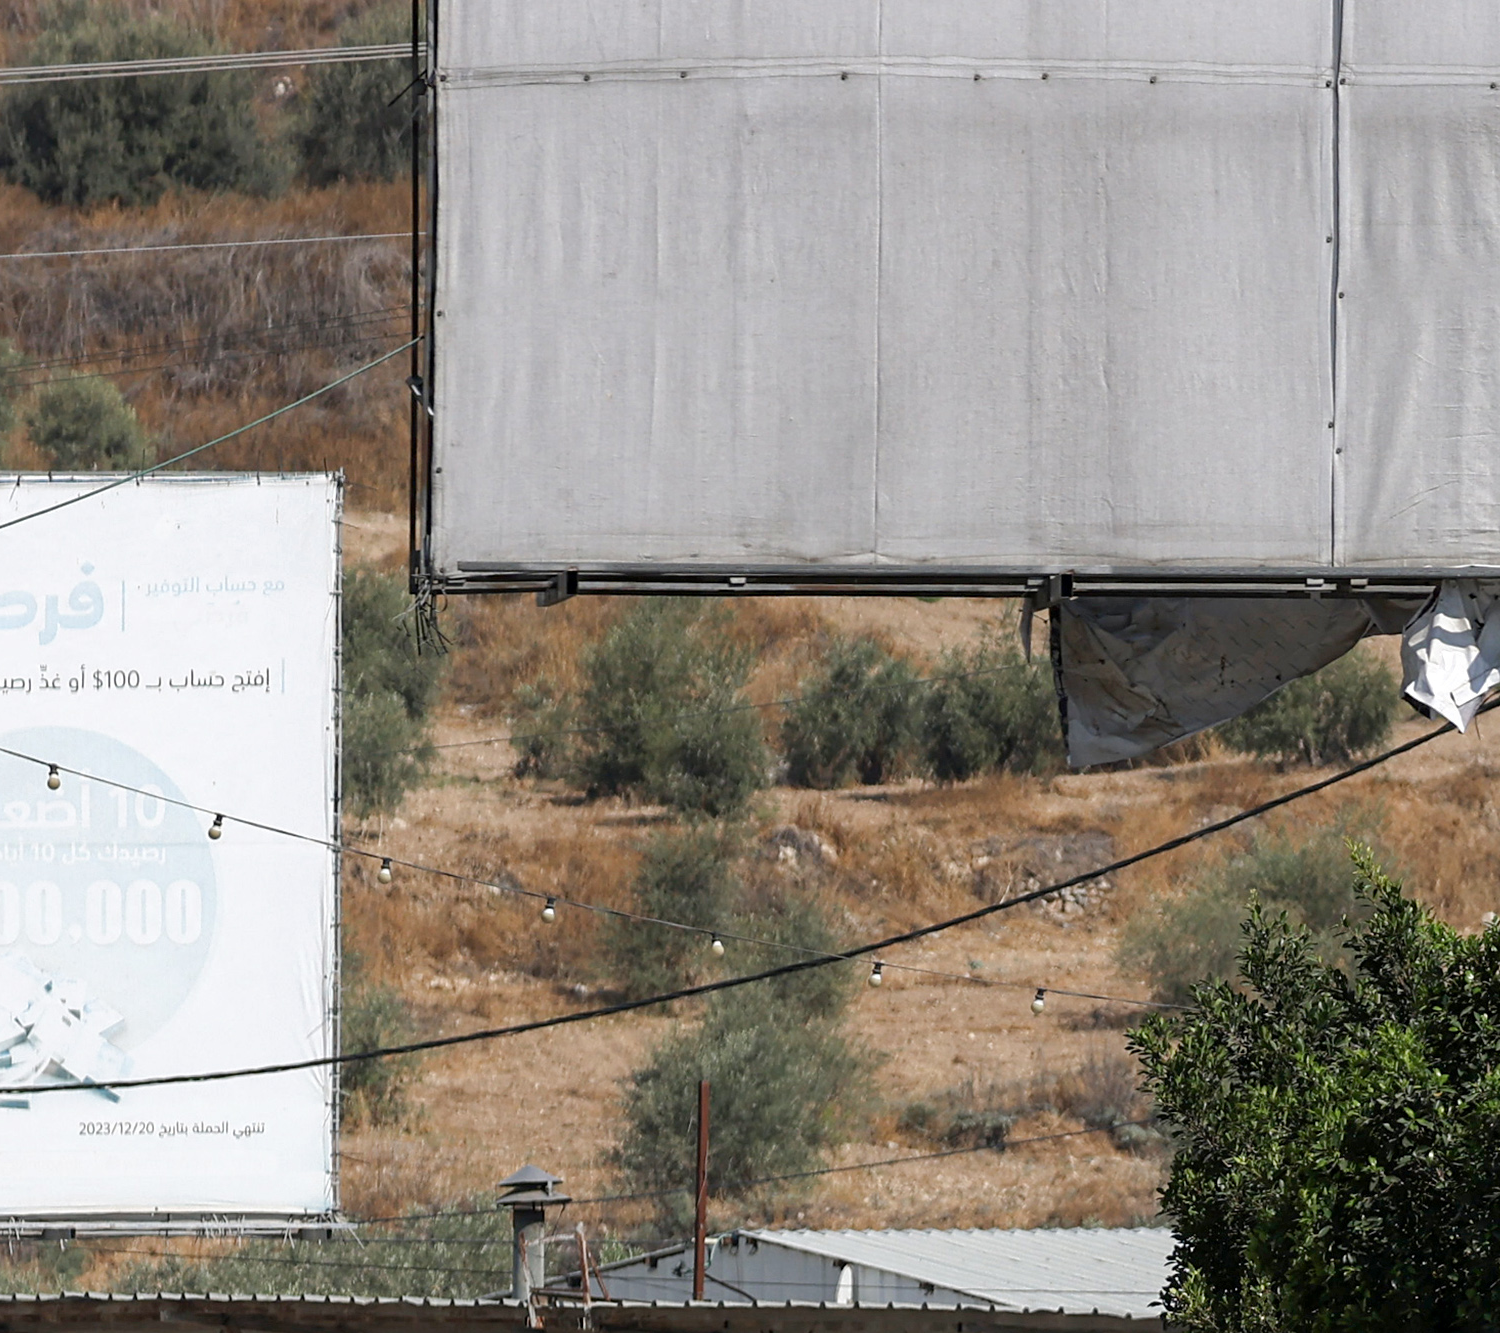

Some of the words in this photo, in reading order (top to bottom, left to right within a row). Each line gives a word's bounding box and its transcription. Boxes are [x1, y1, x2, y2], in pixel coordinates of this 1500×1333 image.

[145, 576, 199, 597] التوفير
[206, 575, 256, 596] حساب
[262, 580, 285, 595] مع
[69, 664, 87, 693] أو
[168, 667, 226, 692] حساب
[231, 666, 271, 695] إفتح
[108, 784, 166, 828] 10
[30, 846, 55, 861] 10
[62, 844, 89, 864] كل
[78, 1121, 155, 1137] 2023/12/20
[158, 1121, 188, 1139] بتاريخ
[192, 1120, 228, 1135] الحملة
[232, 1121, 266, 1138] تنتهي
